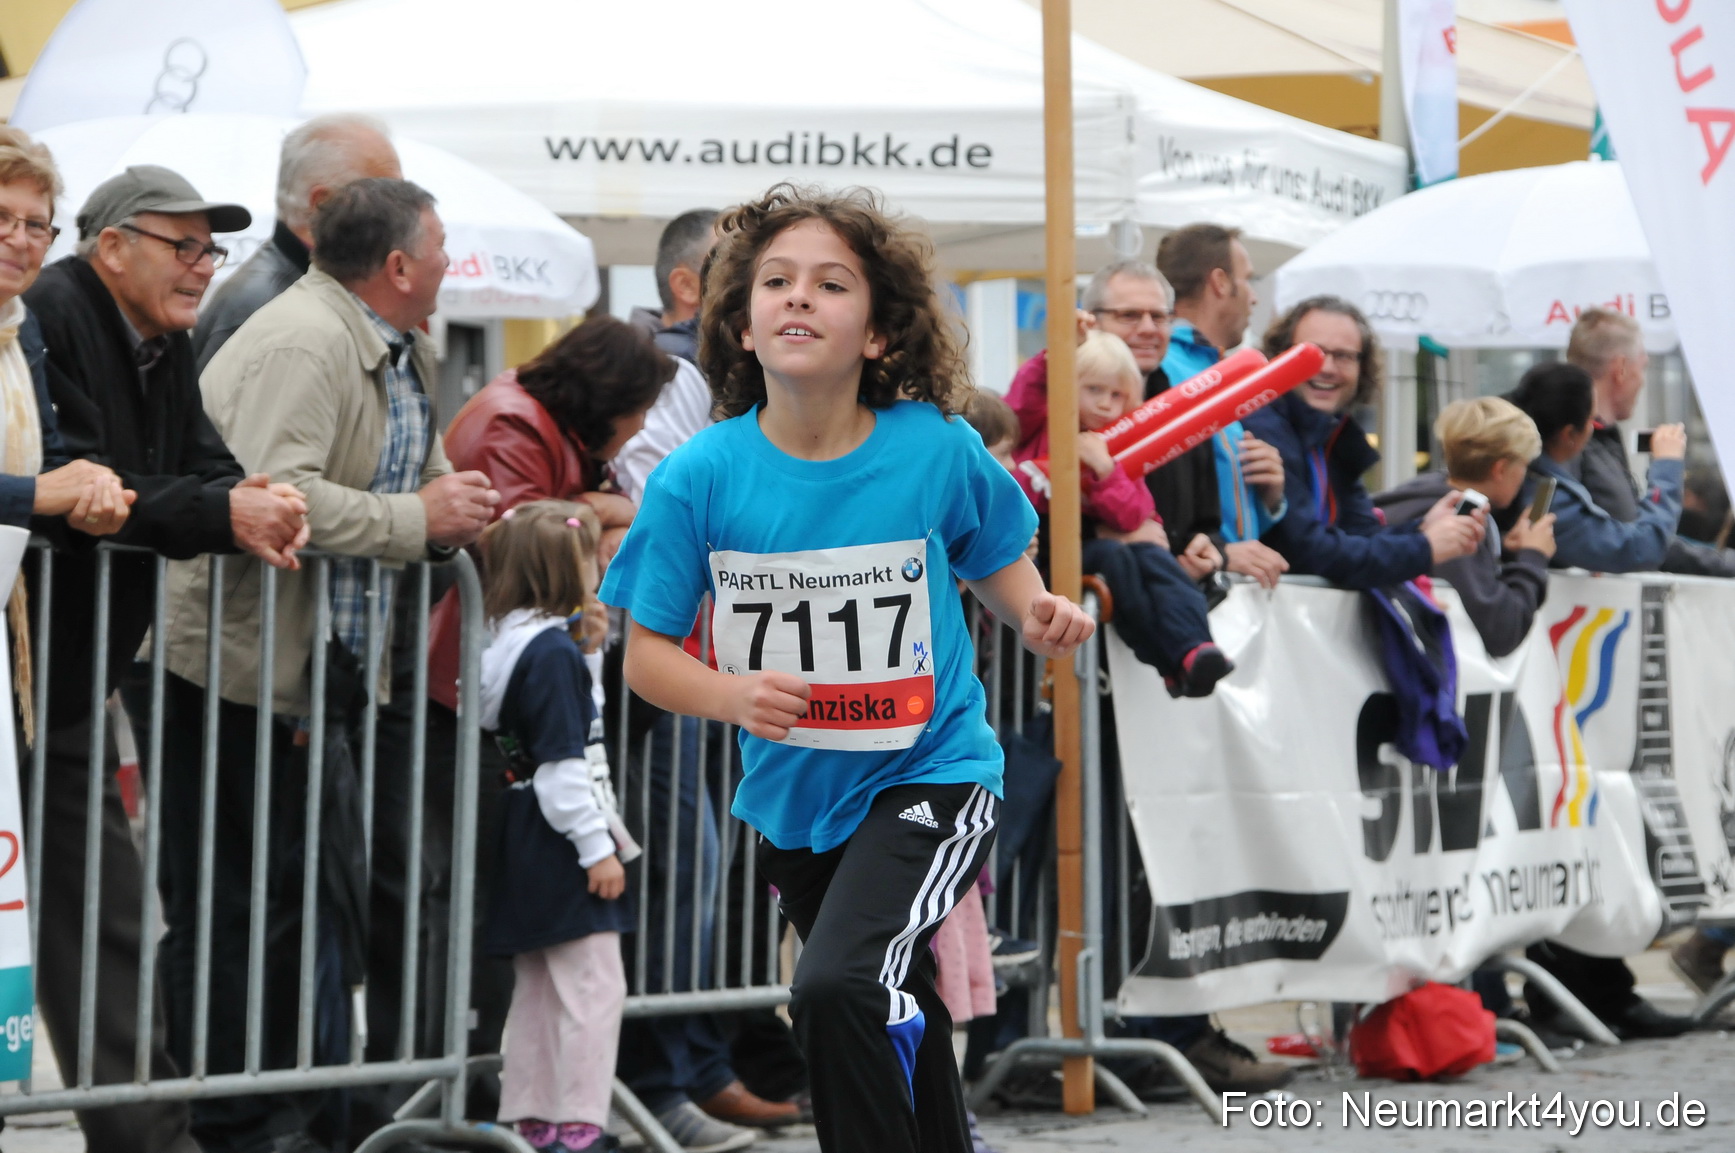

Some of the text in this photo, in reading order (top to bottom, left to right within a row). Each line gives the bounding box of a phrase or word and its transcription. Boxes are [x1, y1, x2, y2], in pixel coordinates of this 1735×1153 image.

[544, 131, 994, 169] www.audibkk.de
[444, 251, 553, 287] udi BKK
[718, 566, 894, 591] PARTL Neumarkt
[731, 593, 912, 672] 7117
[913, 641, 925, 656] M
[798, 693, 897, 722] nziska
[898, 812, 939, 829] adidas
